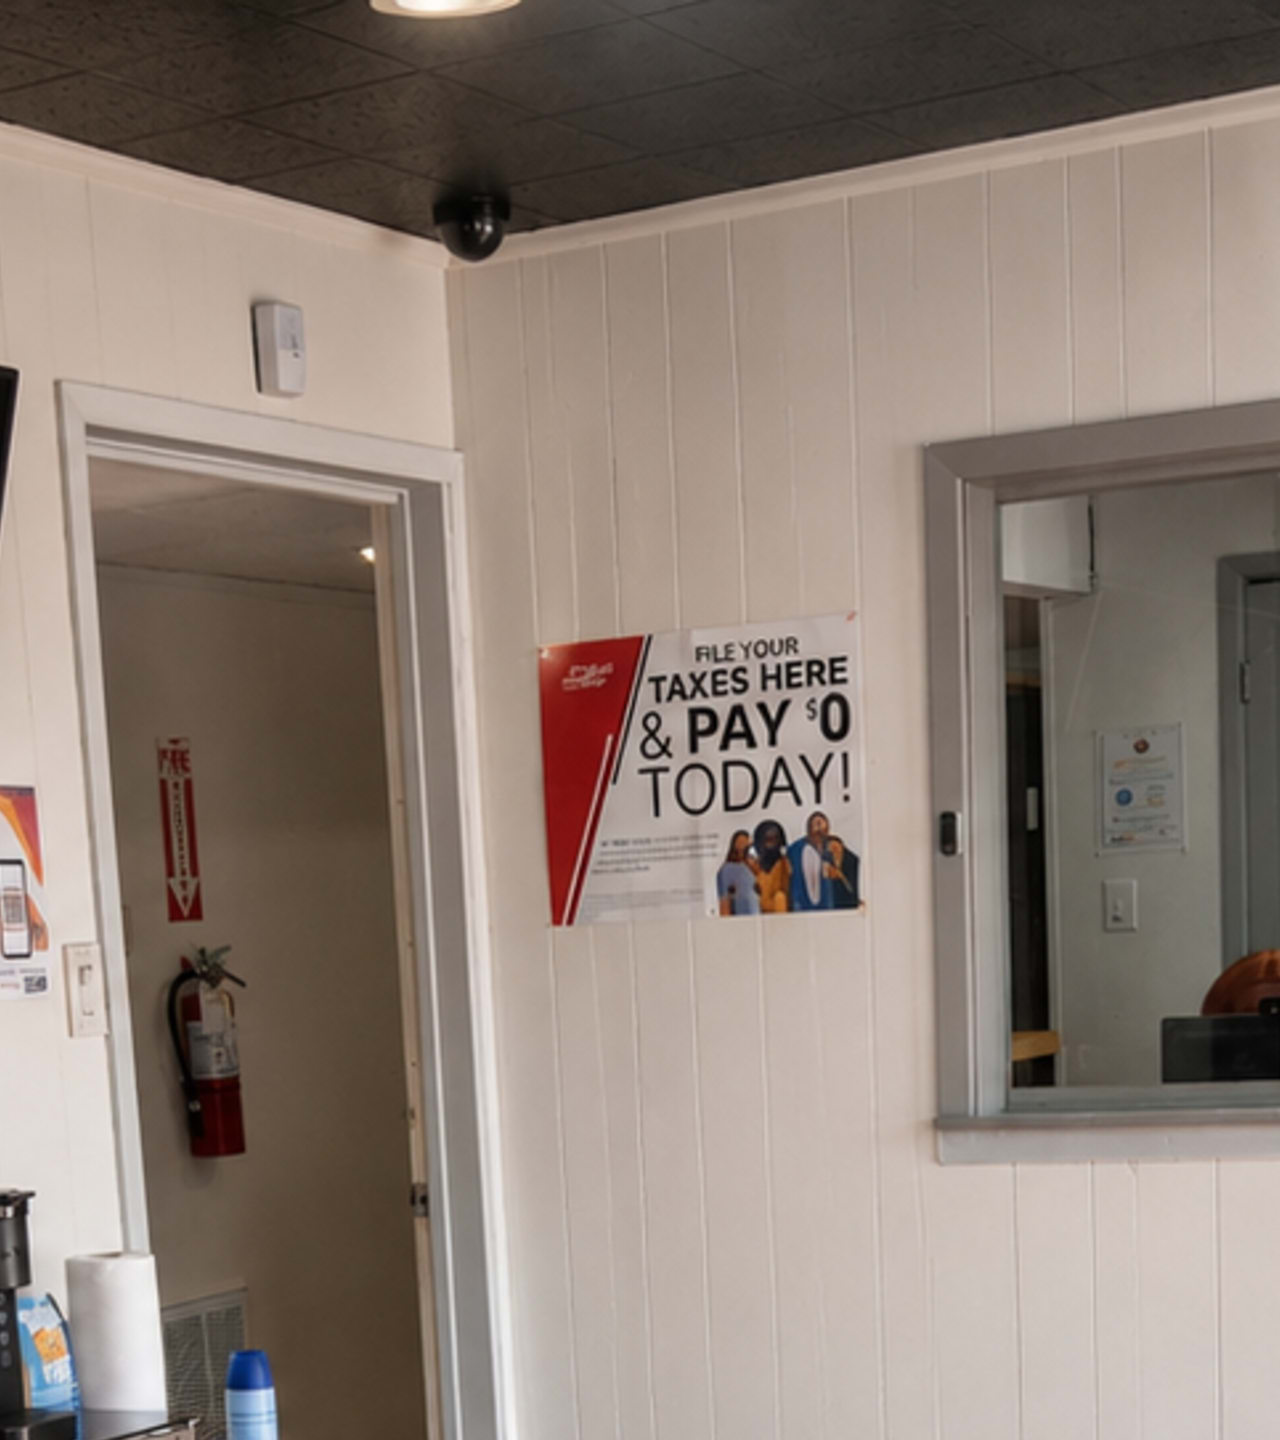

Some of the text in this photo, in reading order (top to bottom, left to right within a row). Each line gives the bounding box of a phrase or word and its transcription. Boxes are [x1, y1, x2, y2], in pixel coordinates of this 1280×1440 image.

[695, 636, 799, 664] FILE YOUR
[647, 666, 750, 704] TAXES
[760, 656, 849, 692] HERE
[638, 691, 851, 761] & PAY $0
[637, 751, 851, 818] TODAY!
